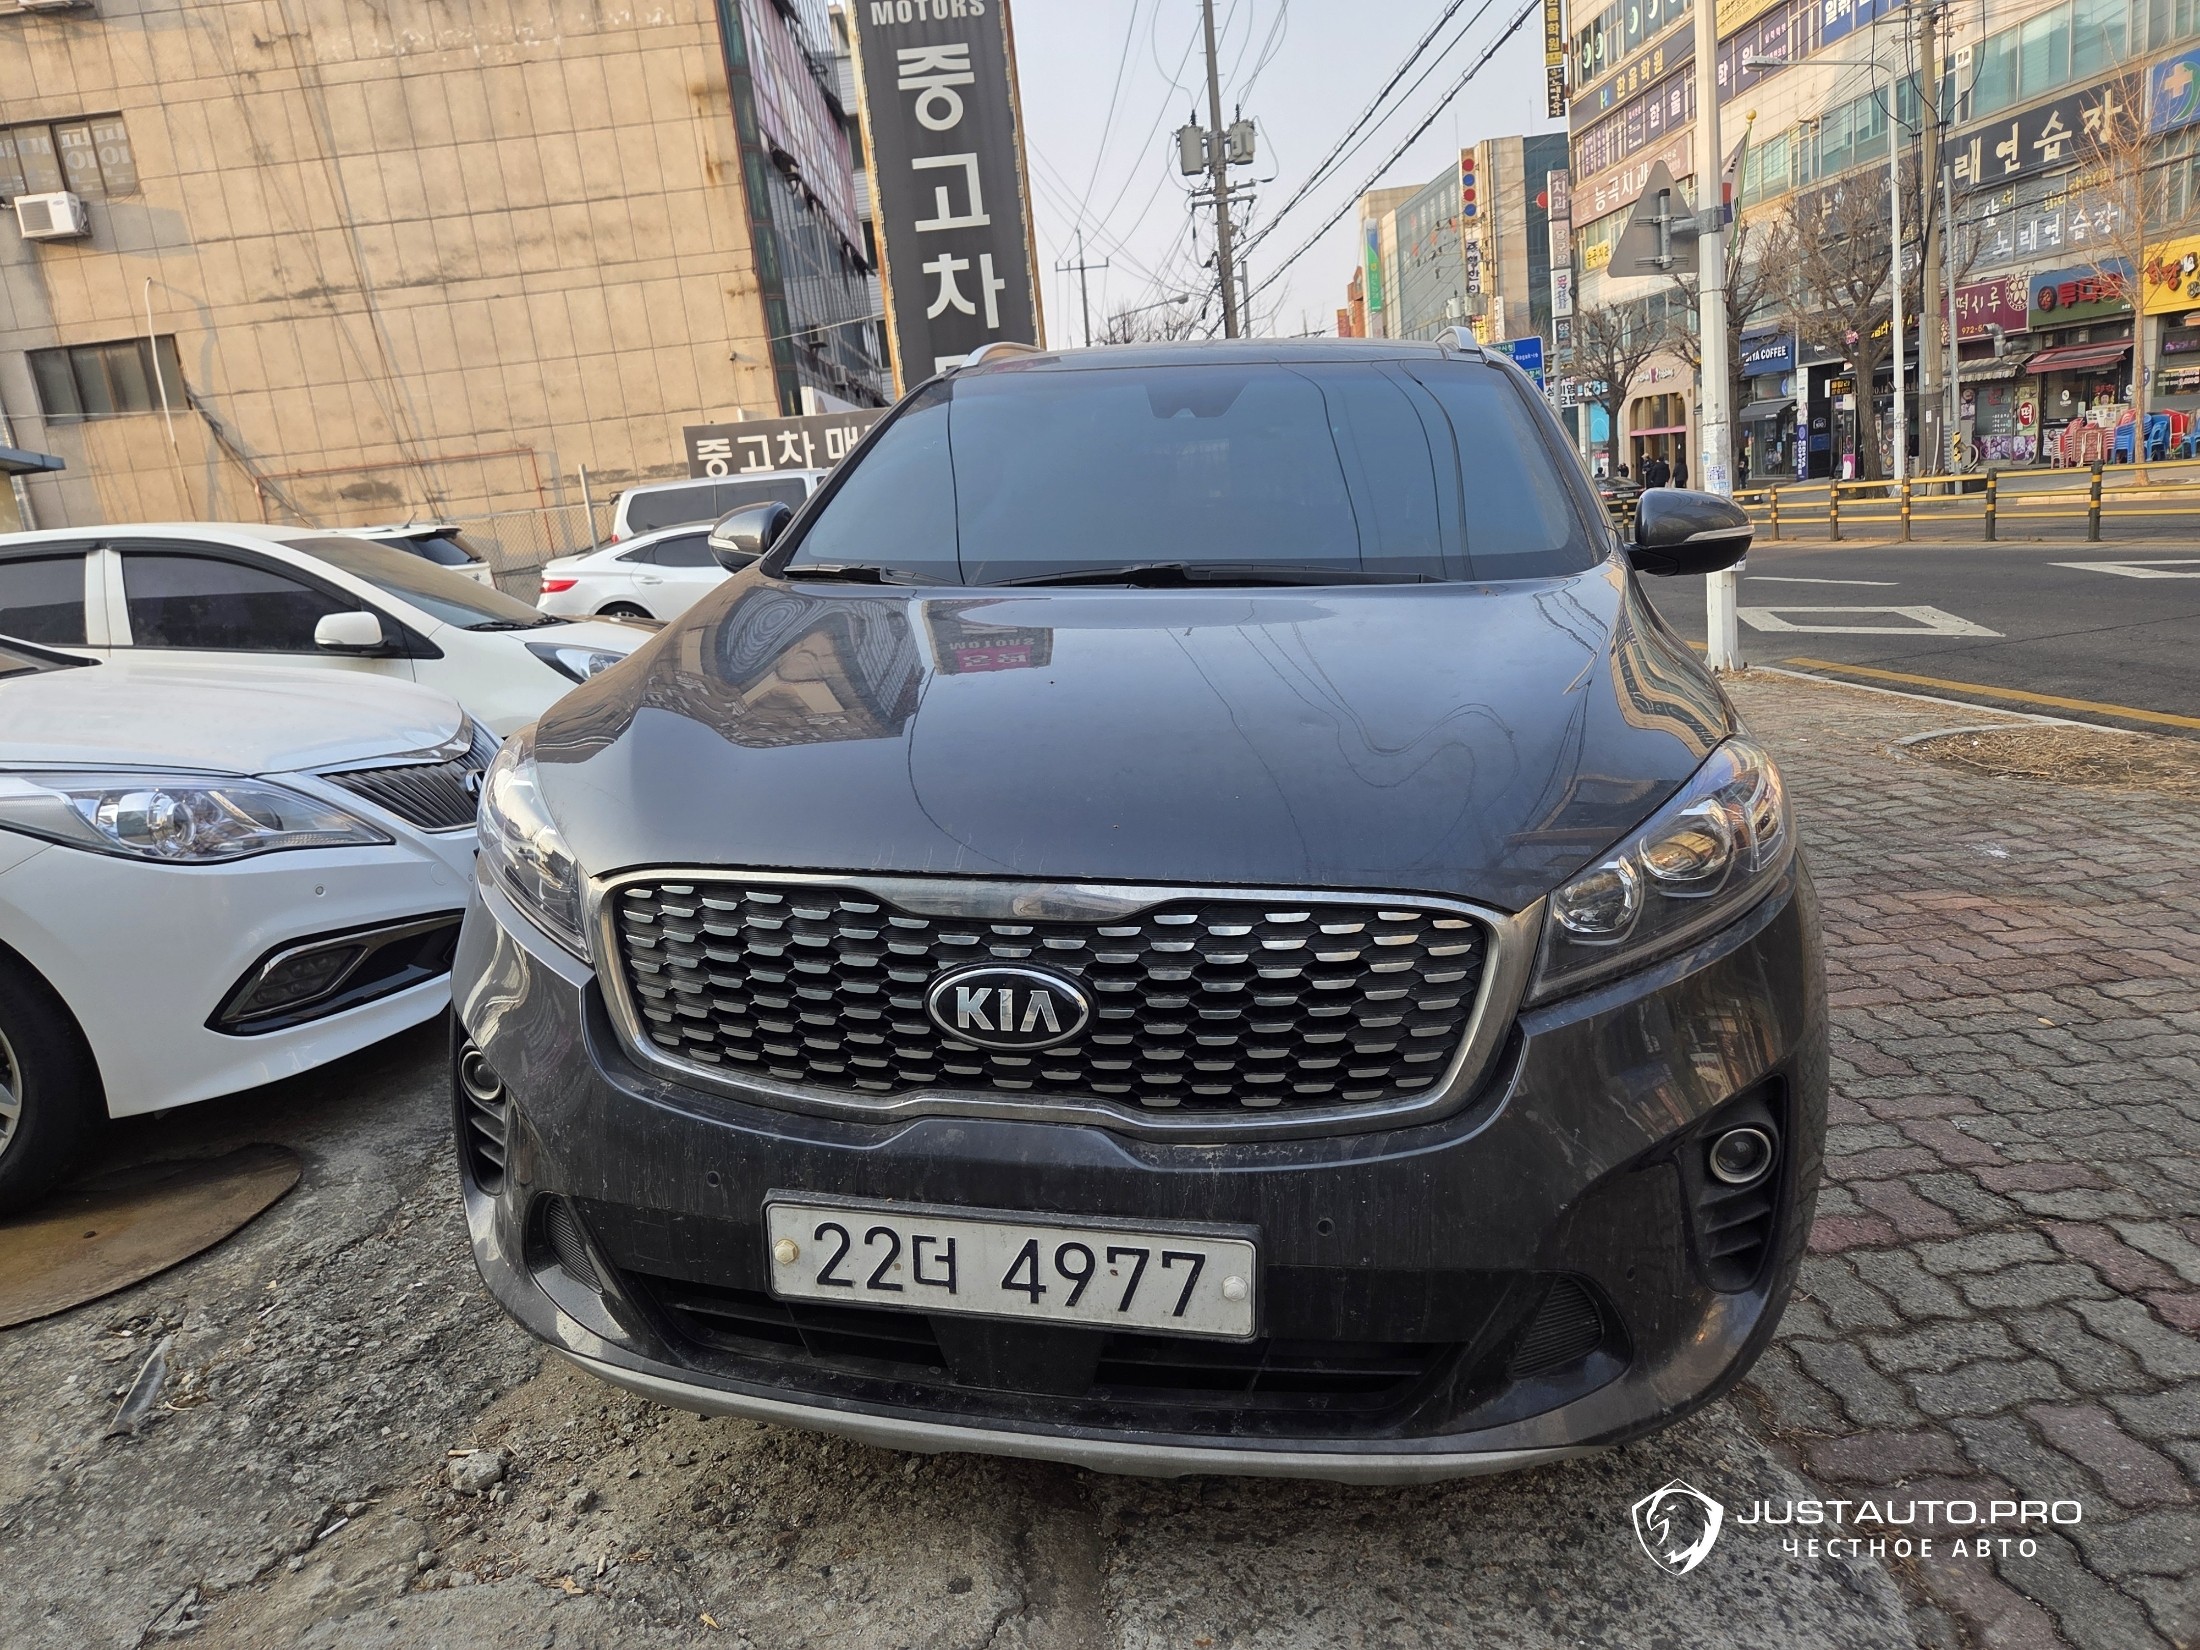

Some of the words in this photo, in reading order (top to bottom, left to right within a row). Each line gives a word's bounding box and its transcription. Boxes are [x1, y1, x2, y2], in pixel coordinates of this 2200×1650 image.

[896, 43, 1006, 330] 중고차
[1992, 201, 2118, 255] 노래연습장
[1956, 286, 2001, 320] 떡시루
[1760, 345, 1787, 360] COFFEE
[696, 430, 816, 479] 중고차
[955, 986, 1062, 1033] KIA
[813, 1221, 957, 1295] 22더
[1001, 1237, 1207, 1318] 4977
